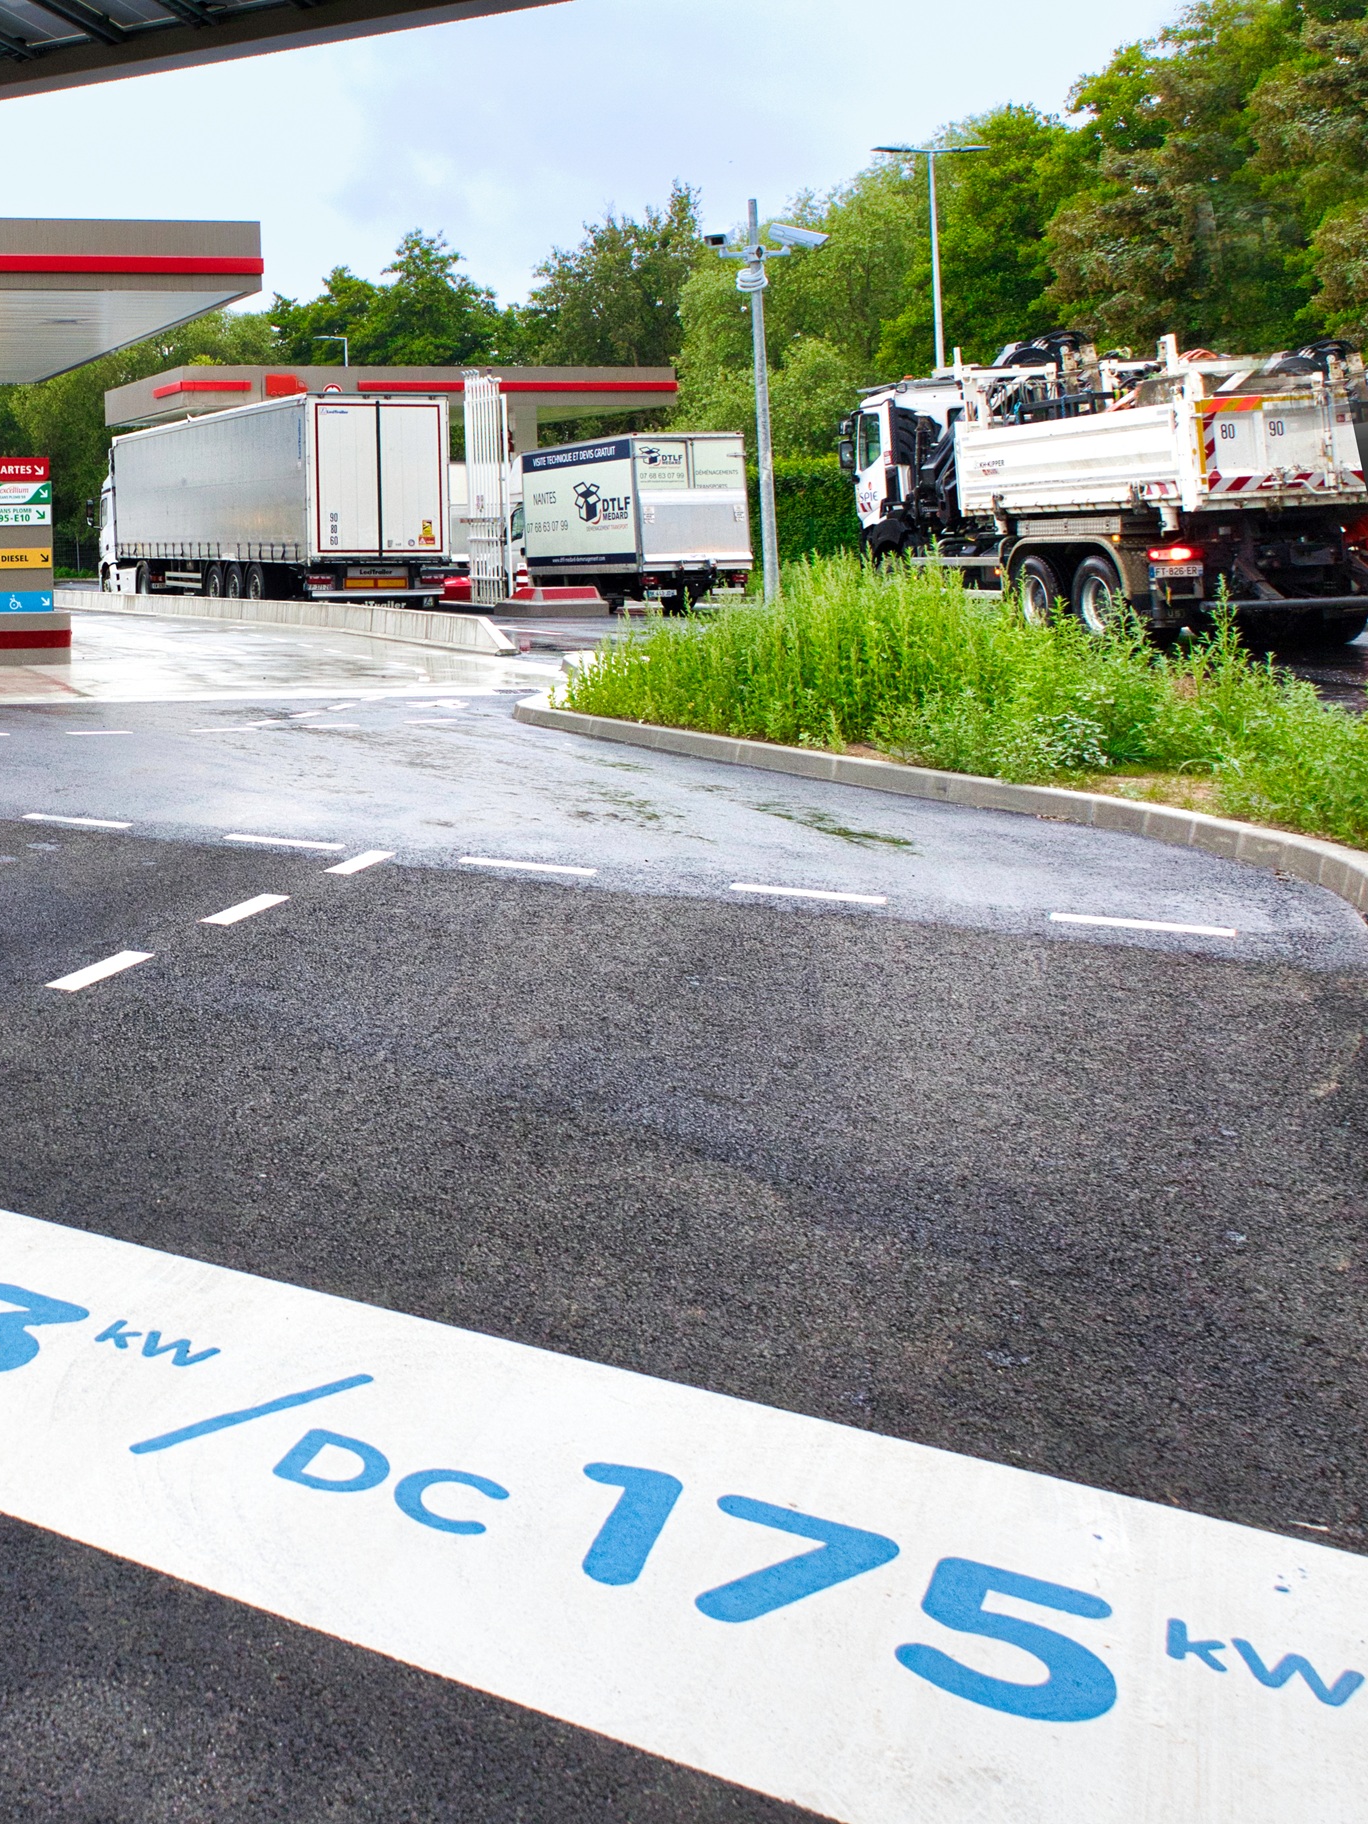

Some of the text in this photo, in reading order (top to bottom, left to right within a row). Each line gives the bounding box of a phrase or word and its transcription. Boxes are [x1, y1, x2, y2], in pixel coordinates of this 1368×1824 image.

[1220, 423, 1236, 440] 80
[1268, 420, 1284, 437] 90
[532, 446, 616, 467] VISITE TECHNIQUE ET DEVIS GRATUIT
[640, 472, 685, 480] 07 68 63 07 99
[0, 486, 29, 494] excellium
[859, 490, 878, 502] SPIE
[533, 490, 557, 506] NANTES
[601, 496, 631, 512] DTLF
[329, 512, 339, 523] 90
[602, 511, 629, 521] MEDARD
[330, 524, 338, 534] 80
[526, 519, 569, 534] 07 68 63 07 99
[329, 535, 339, 546] 60
[1, 555, 29, 563] DIESEL
[1155, 566, 1198, 576] FT-826-ER
[95, 1319, 221, 1367] kW
[129, 1374, 375, 1455] /
[273, 1428, 510, 1535] DC
[582, 1461, 1119, 1723] 175
[1166, 1618, 1366, 1707] kW
